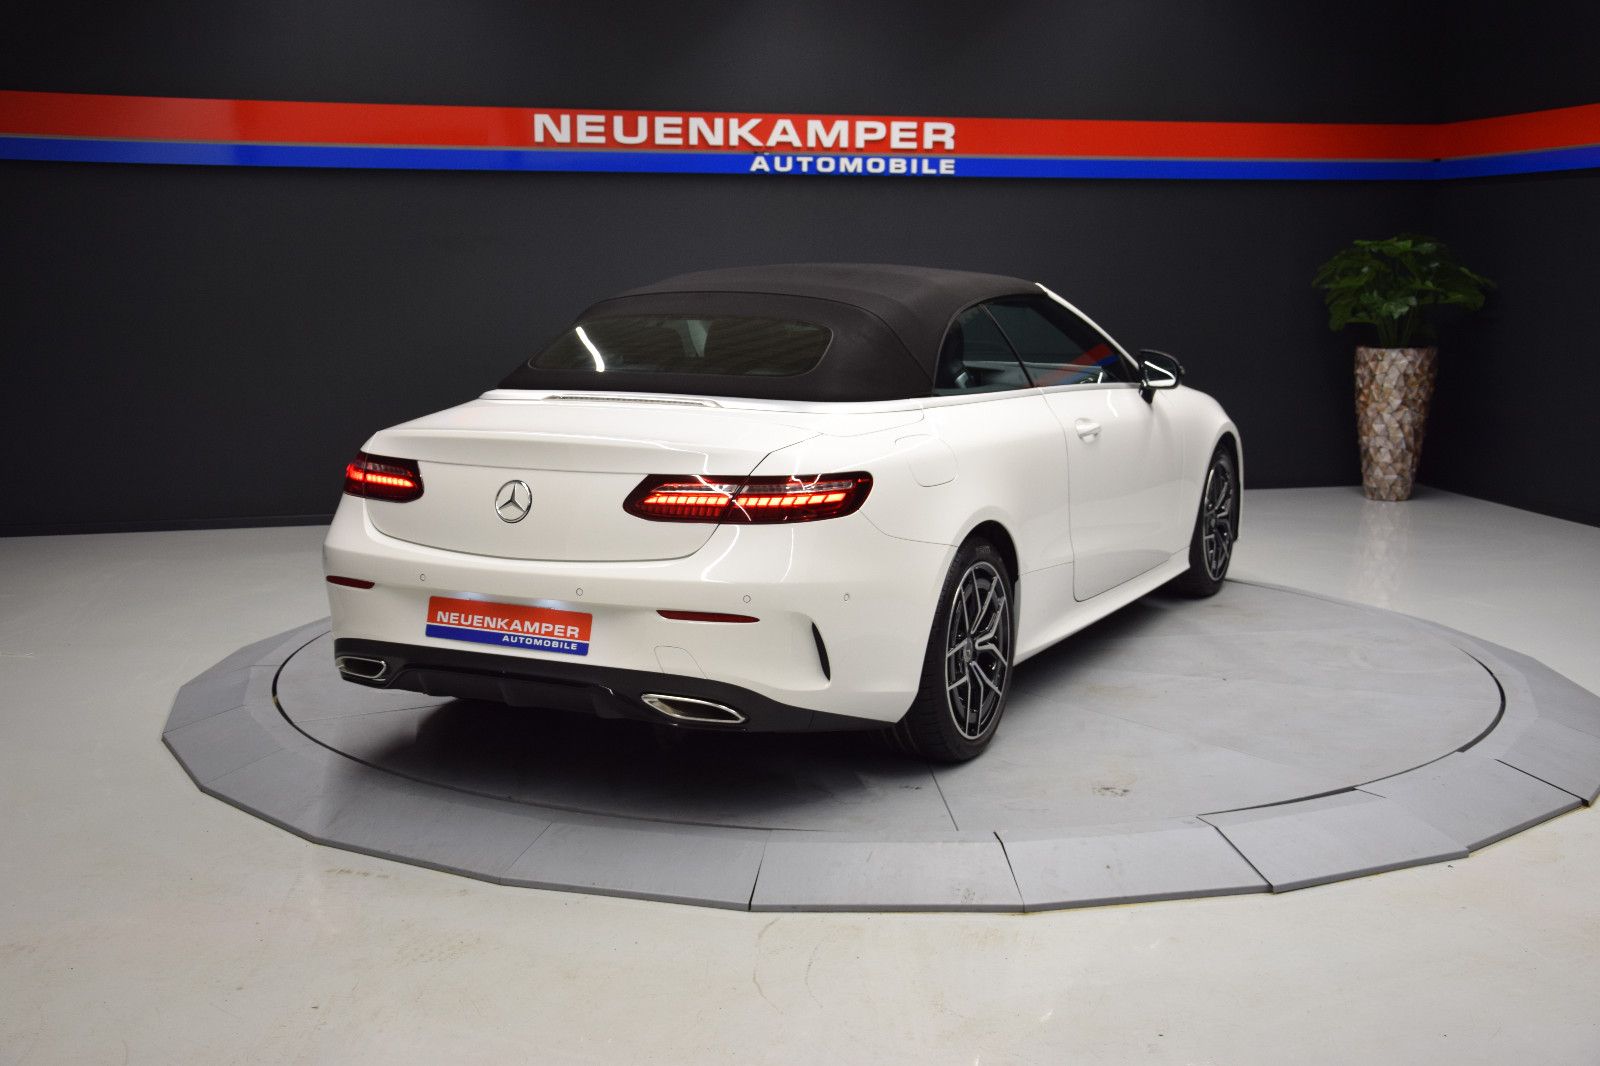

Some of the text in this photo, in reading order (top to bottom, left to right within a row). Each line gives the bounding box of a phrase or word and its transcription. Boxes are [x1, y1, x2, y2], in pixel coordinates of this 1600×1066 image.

[533, 114, 956, 150] NEUENKAMPER
[750, 155, 956, 175] AUTOMOBILE
[436, 611, 580, 638] NEUENKAMPER
[502, 635, 578, 650] AUTOMOBILE
